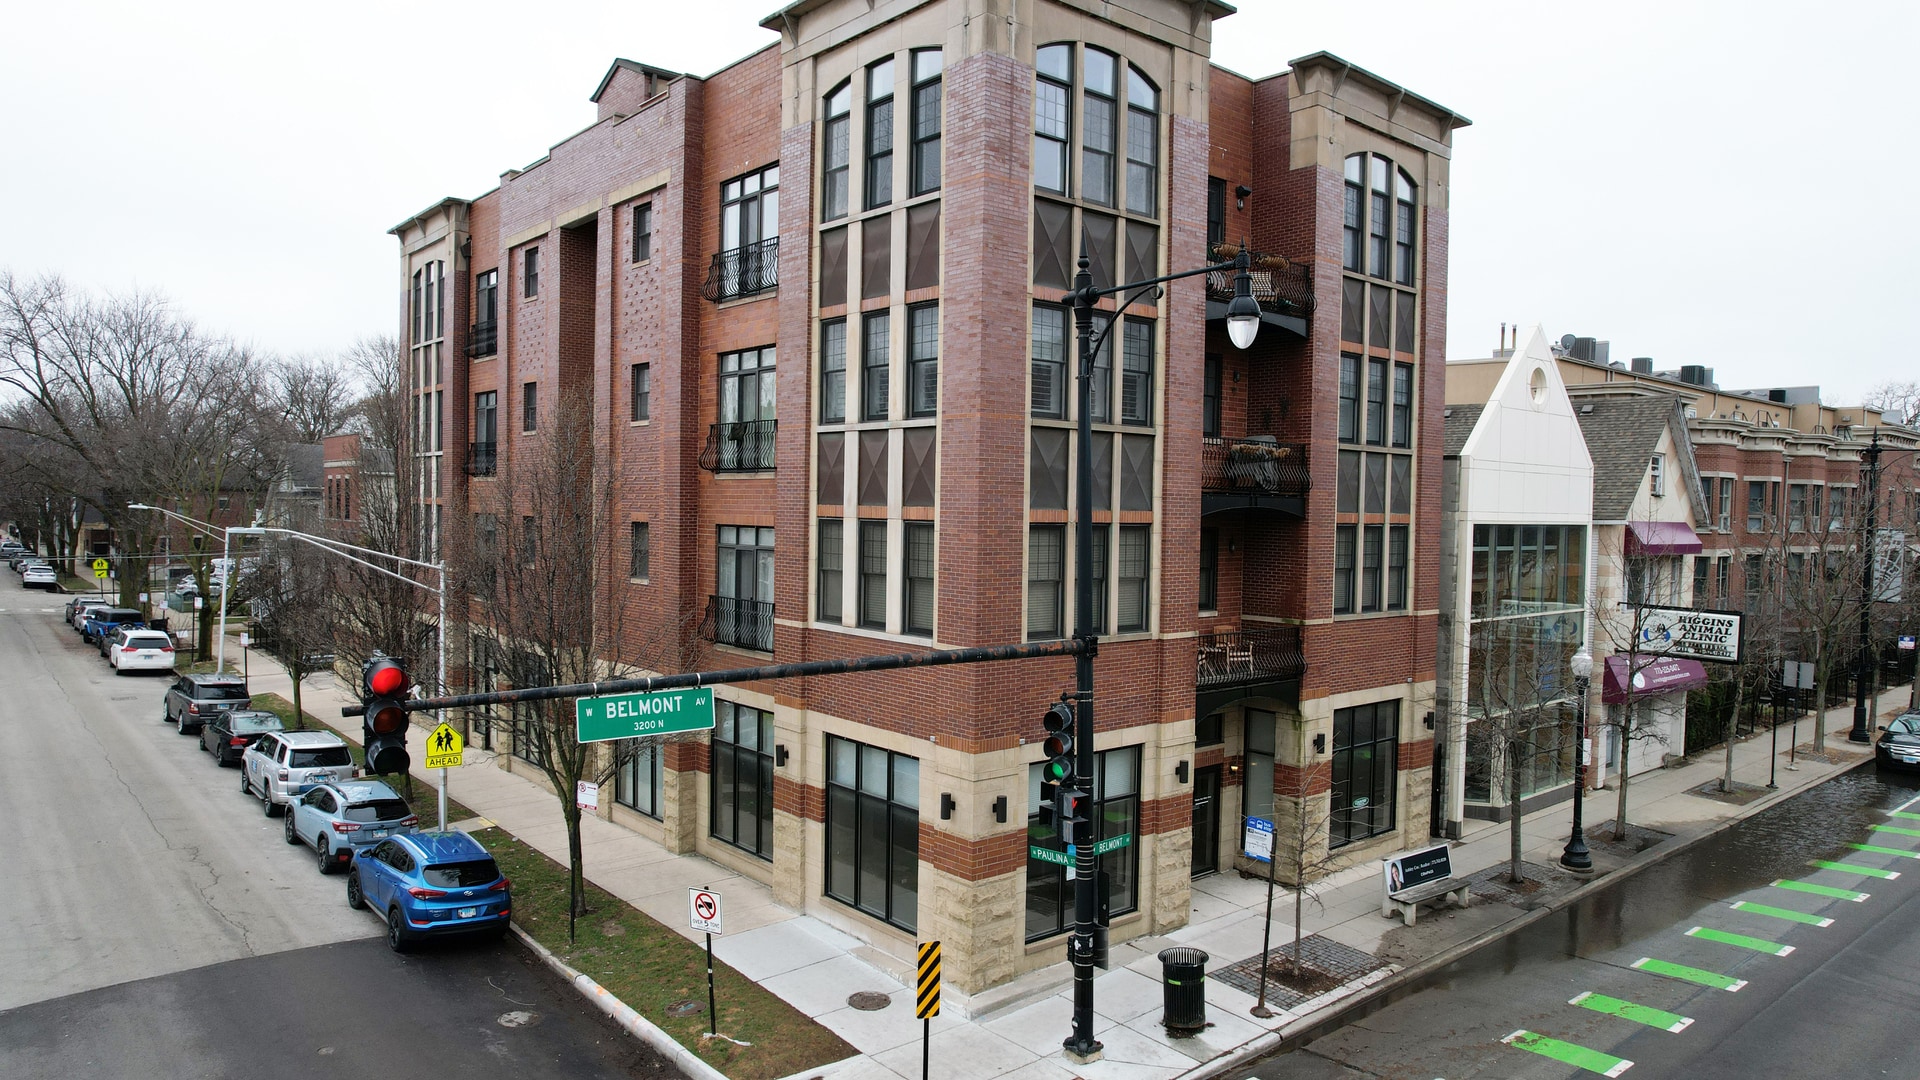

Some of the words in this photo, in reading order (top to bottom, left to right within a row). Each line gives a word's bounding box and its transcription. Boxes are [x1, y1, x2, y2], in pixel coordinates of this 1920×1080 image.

[1679, 615, 1734, 627] HIGGINS
[1678, 624, 1732, 636] ANIMAL
[1683, 633, 1727, 643] CLINIC
[585, 708, 593, 717] W
[606, 696, 683, 719] BELMONT
[695, 697, 706, 706] AV
[633, 720, 656, 731] 3200
[657, 719, 664, 728] N
[429, 756, 459, 766] AHEAD
[1099, 837, 1123, 853] BELMONT
[1037, 850, 1069, 864] PAULINA
